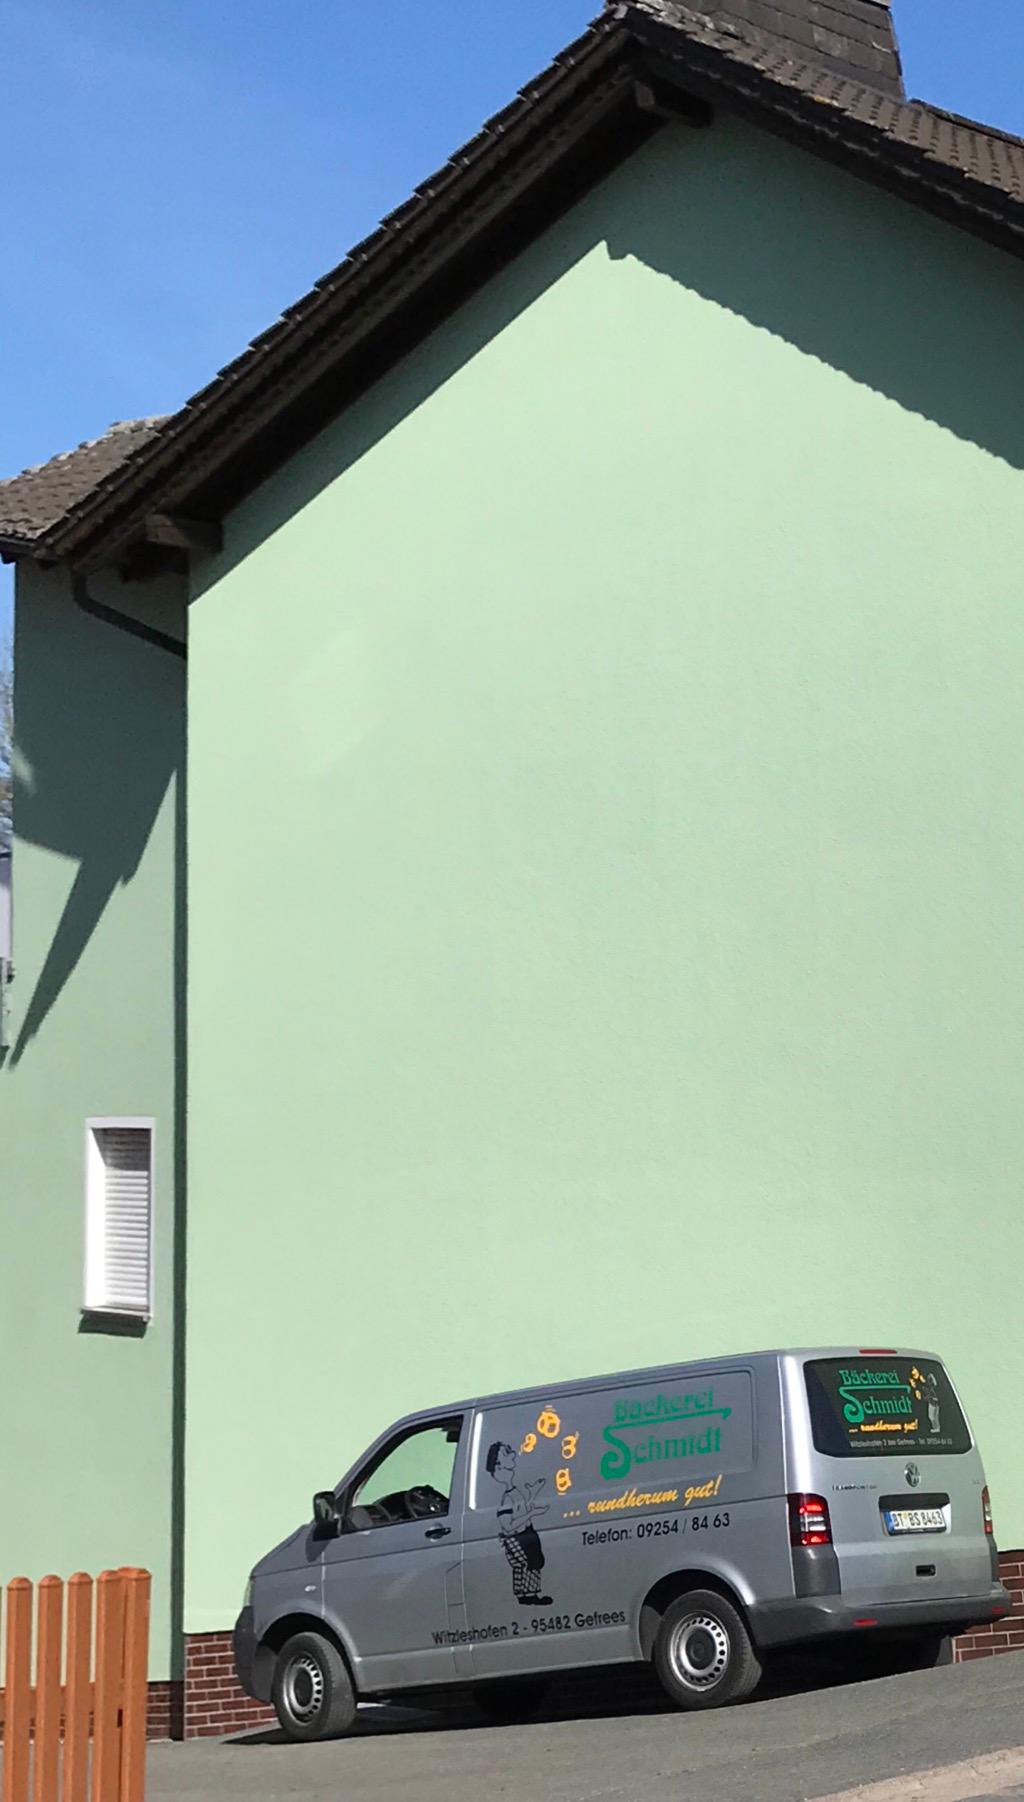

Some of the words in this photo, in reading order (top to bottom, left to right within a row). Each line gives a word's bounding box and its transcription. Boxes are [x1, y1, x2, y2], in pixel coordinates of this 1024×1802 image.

[839, 1369, 900, 1385] Bäckerei
[839, 1385, 912, 1423] Schmidt
[601, 1407, 732, 1480] Schmidt
[587, 1488, 679, 1514] rundherum
[684, 1474, 723, 1507] gut!
[582, 1526, 633, 1546] Telefon:
[637, 1519, 679, 1538] 09254
[691, 1516, 709, 1531] 84
[713, 1512, 730, 1528] 63
[907, 1511, 921, 1526] BS
[920, 1510, 943, 1526] 8463
[432, 1624, 508, 1645] Witzleshofen
[511, 1622, 520, 1635] 2
[531, 1615, 571, 1632] 95482
[574, 1610, 626, 1628] Gefrees
